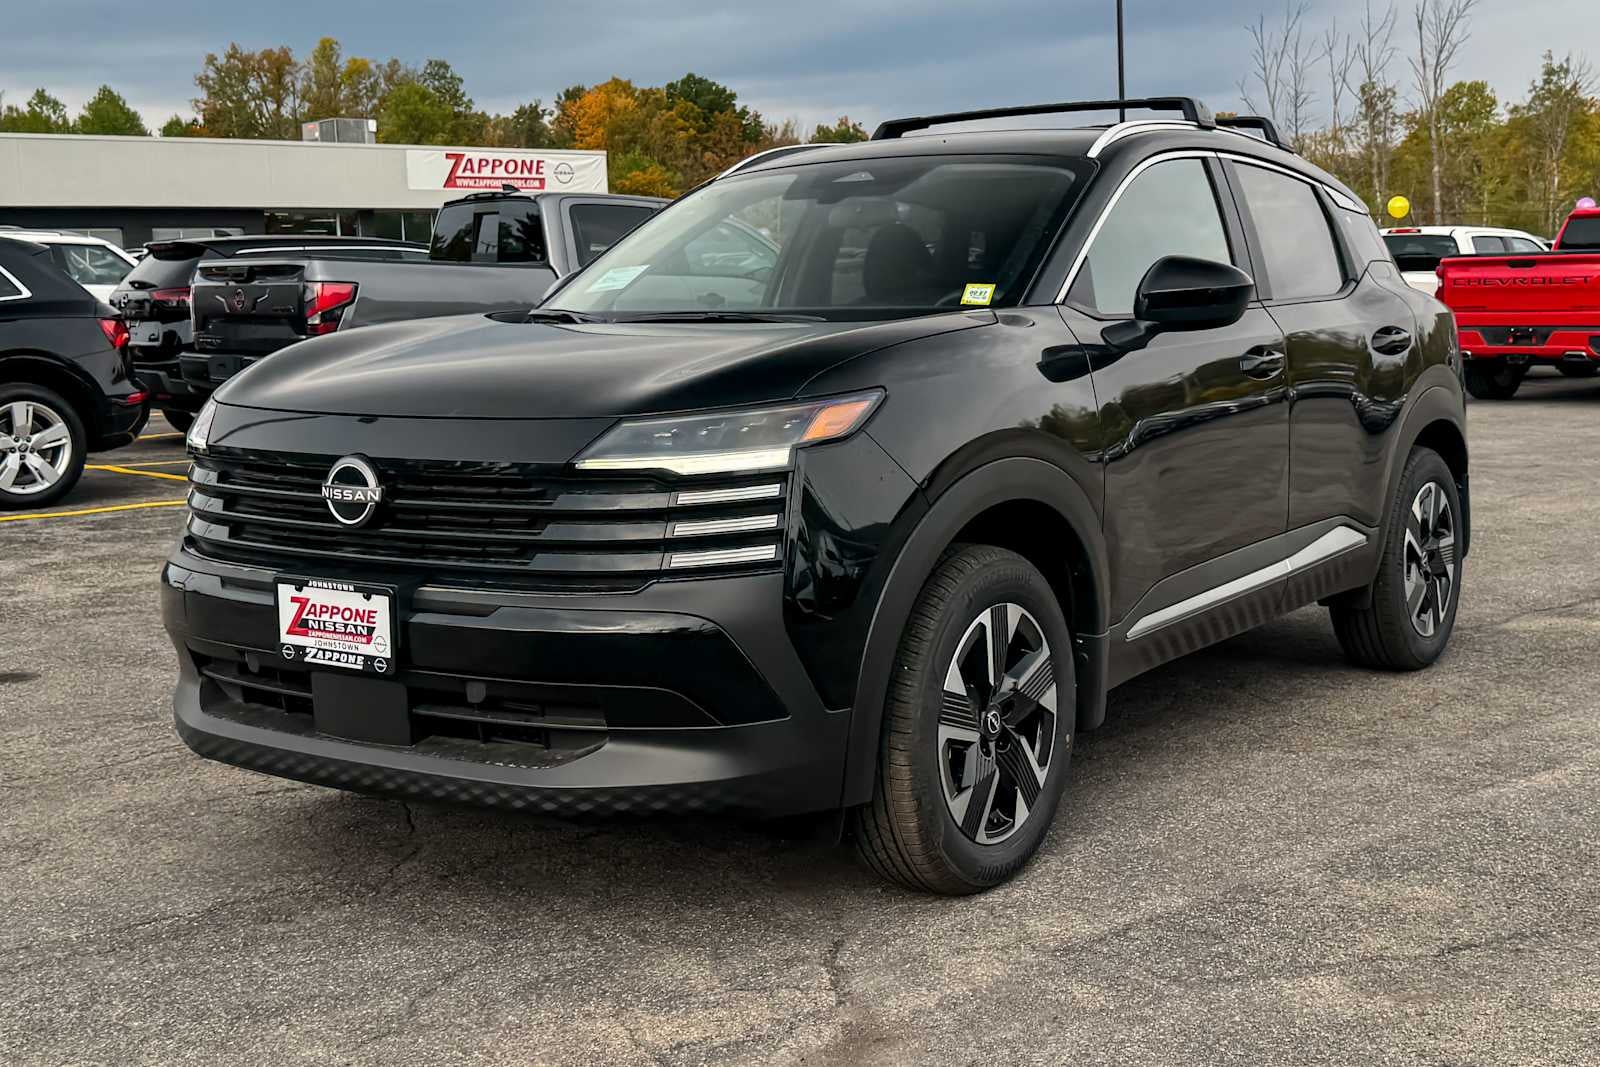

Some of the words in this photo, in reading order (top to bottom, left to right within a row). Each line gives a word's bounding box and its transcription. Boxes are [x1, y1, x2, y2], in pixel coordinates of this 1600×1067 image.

[444, 153, 545, 187] ZAPPONE
[1453, 276, 1593, 287] CHEVROLET
[321, 486, 379, 501] NISSAN
[308, 580, 355, 591] JOHNSTOWN
[286, 596, 378, 634] ZAPPONE
[308, 620, 368, 635] NISSAN
[314, 640, 360, 652] JOHNSTOWN
[304, 647, 365, 669] ZAPPONE
